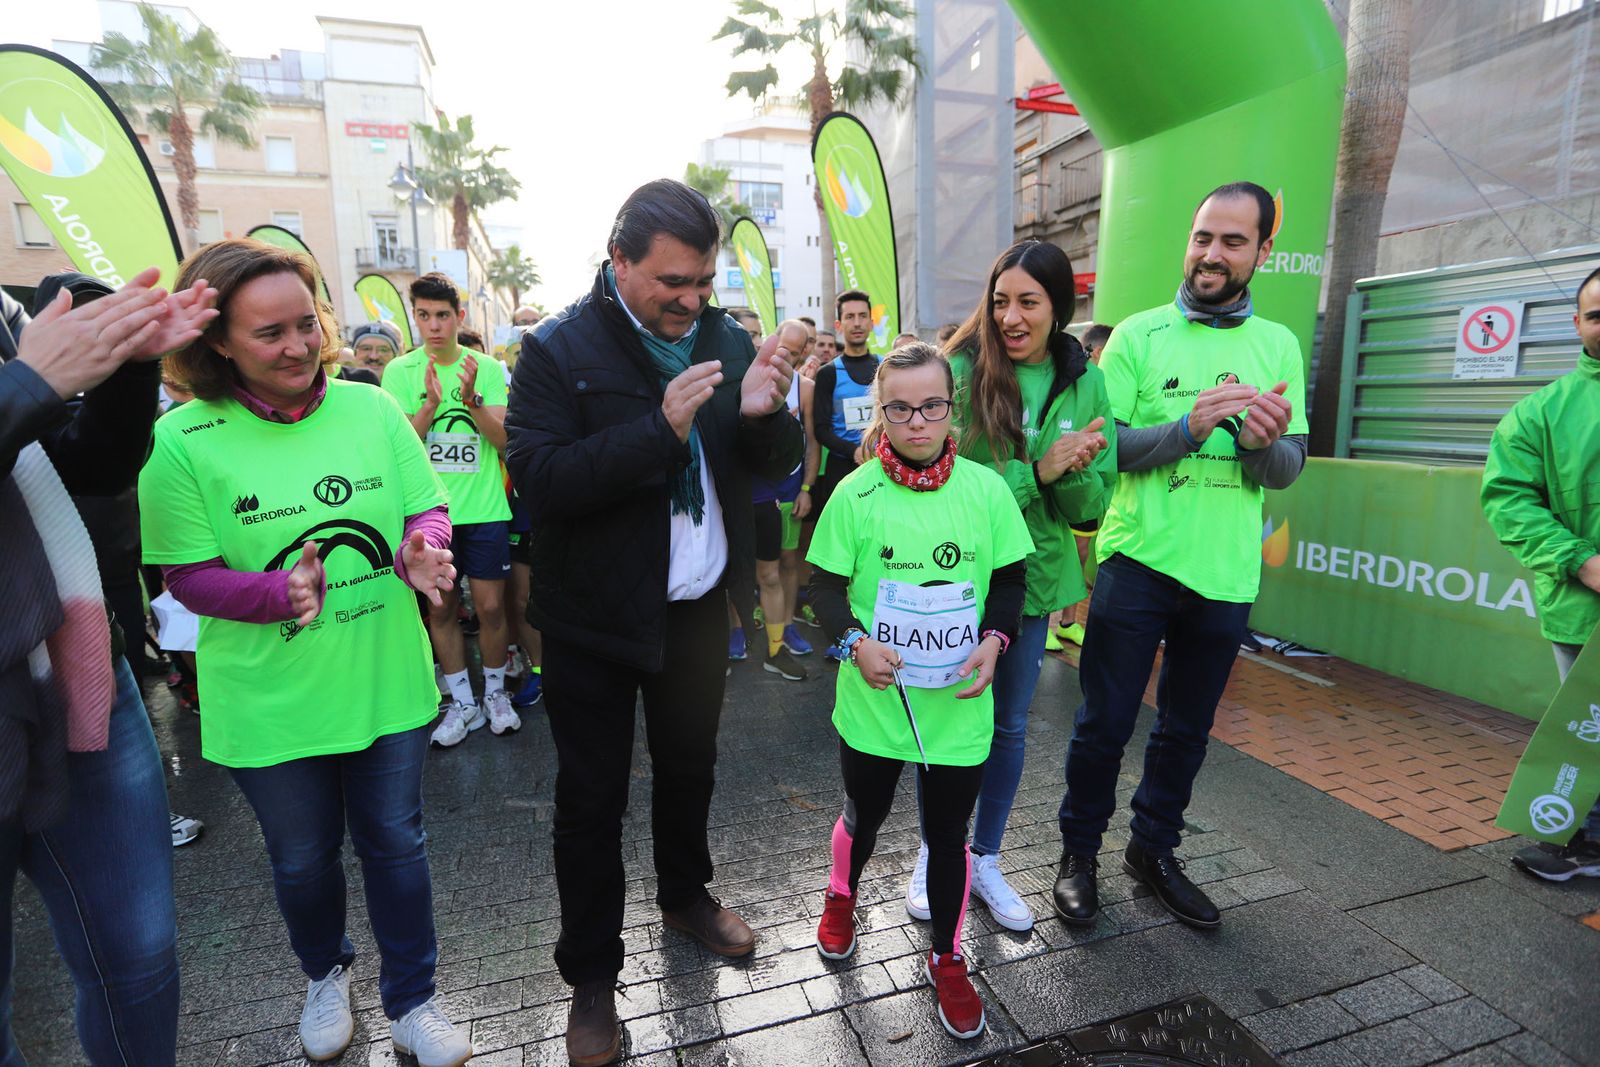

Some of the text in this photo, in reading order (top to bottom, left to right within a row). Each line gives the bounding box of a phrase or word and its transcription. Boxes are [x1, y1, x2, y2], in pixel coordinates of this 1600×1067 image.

[1259, 251, 1324, 275] ERDRO
[430, 444, 476, 463] 246
[355, 482, 384, 492] MUJER
[241, 504, 307, 526] IBERDROLA
[335, 580, 348, 589] LA
[349, 568, 392, 586] IGUALDAD
[1295, 540, 1536, 618] IBERDROLA
[876, 622, 975, 651] BLANCA
[1560, 766, 1579, 798] MUJER
